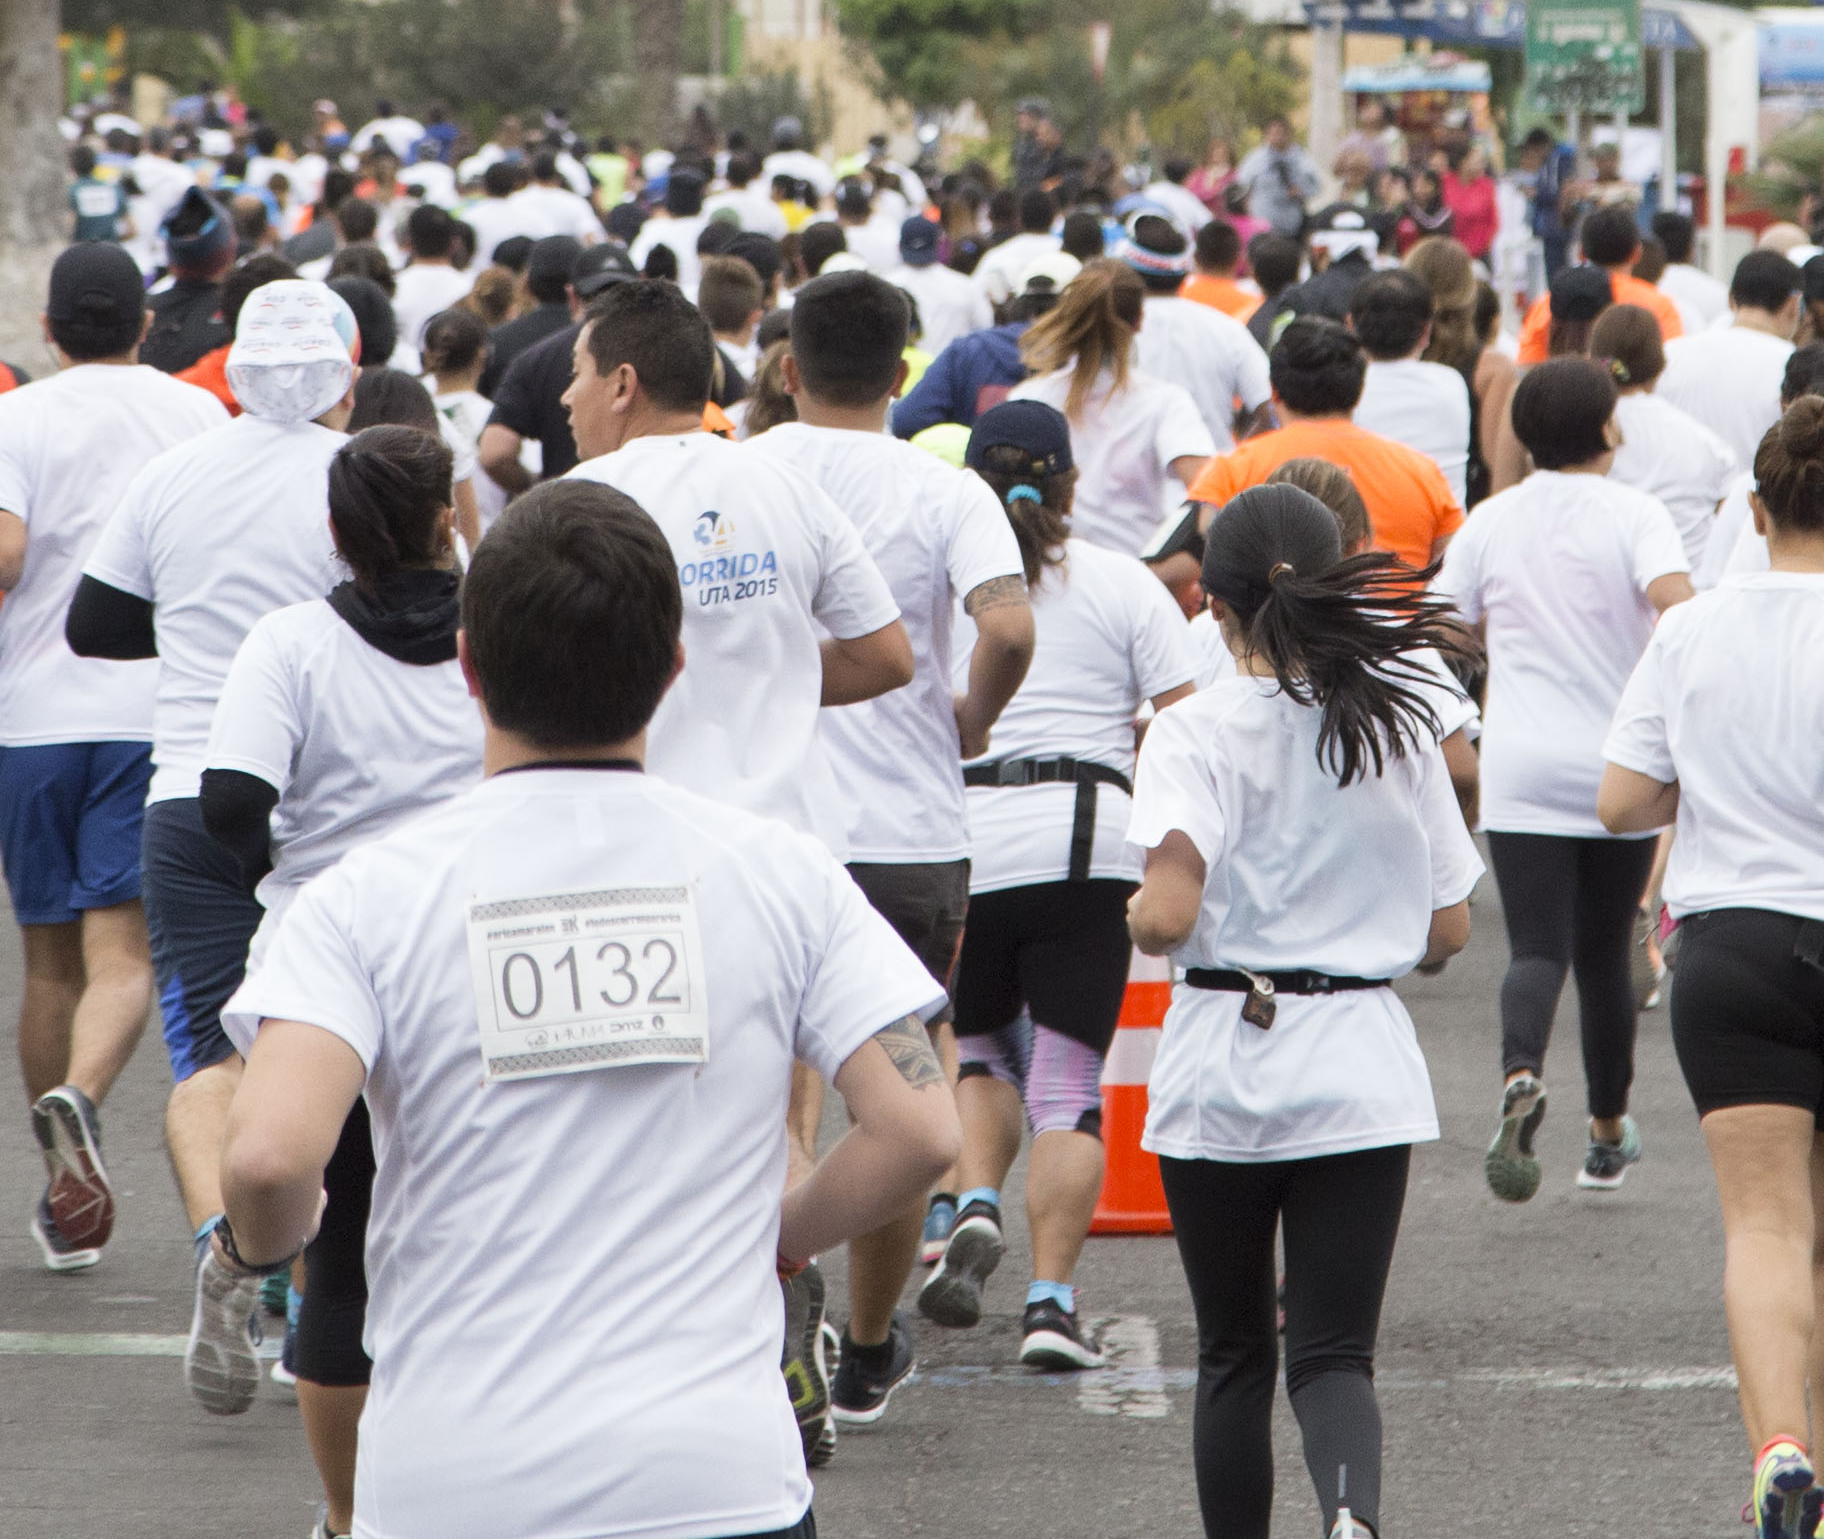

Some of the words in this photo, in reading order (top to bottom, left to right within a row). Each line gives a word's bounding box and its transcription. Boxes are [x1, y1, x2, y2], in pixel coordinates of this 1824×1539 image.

[680, 551, 778, 586] ORRIDA
[699, 585, 731, 606] UTA
[734, 578, 778, 600] 2015
[501, 938, 682, 1021] 0132
